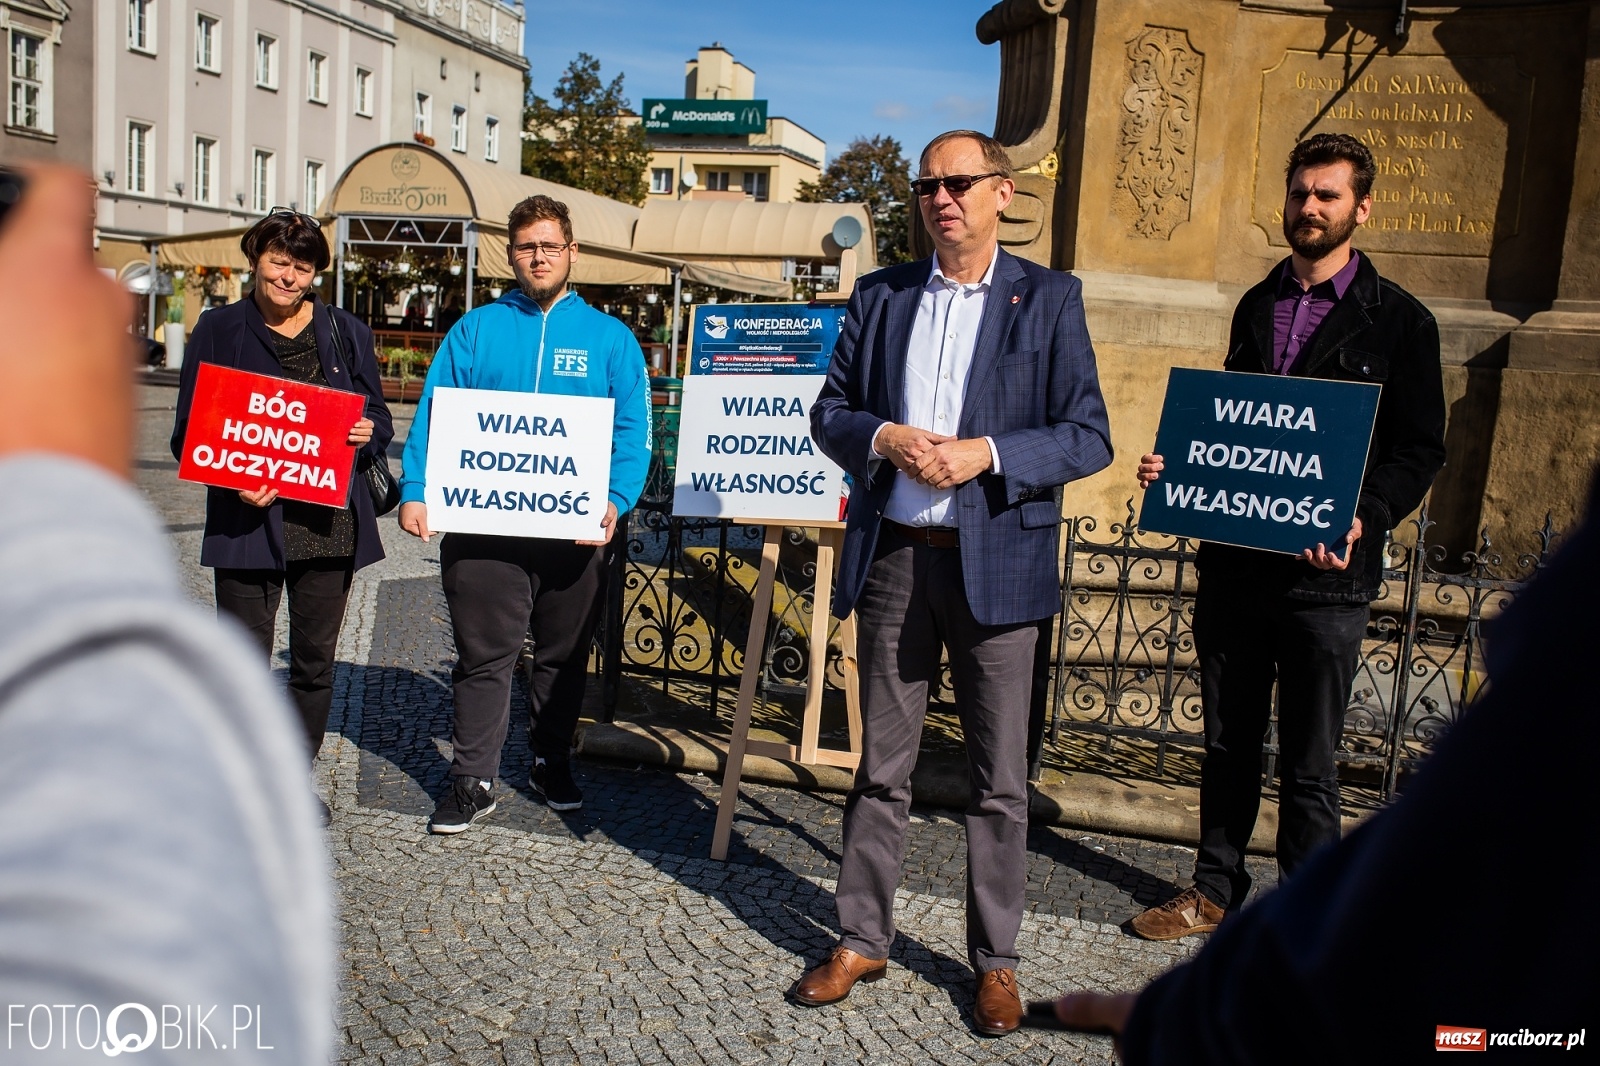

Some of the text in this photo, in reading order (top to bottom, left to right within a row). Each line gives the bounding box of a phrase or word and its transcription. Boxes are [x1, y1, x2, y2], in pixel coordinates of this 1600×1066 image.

[672, 110, 736, 122] McDonald's
[734, 318, 823, 330] KONFEDERACJA
[553, 354, 588, 373] FFS
[248, 390, 307, 424] BÓG
[722, 397, 804, 417] WIARA
[1214, 398, 1316, 432] WIARA
[221, 418, 321, 457] HONOR
[477, 412, 567, 438] WIARA
[706, 434, 814, 456] RODZINA
[192, 445, 337, 491] OJCZYZNA
[460, 449, 578, 477] RODZINA
[1187, 440, 1323, 480] RODZINA
[691, 471, 826, 495] WŁASNOŚĆ
[442, 486, 590, 516] WŁASNOŚĆ
[1165, 482, 1334, 529] WŁASNOŚĆ
